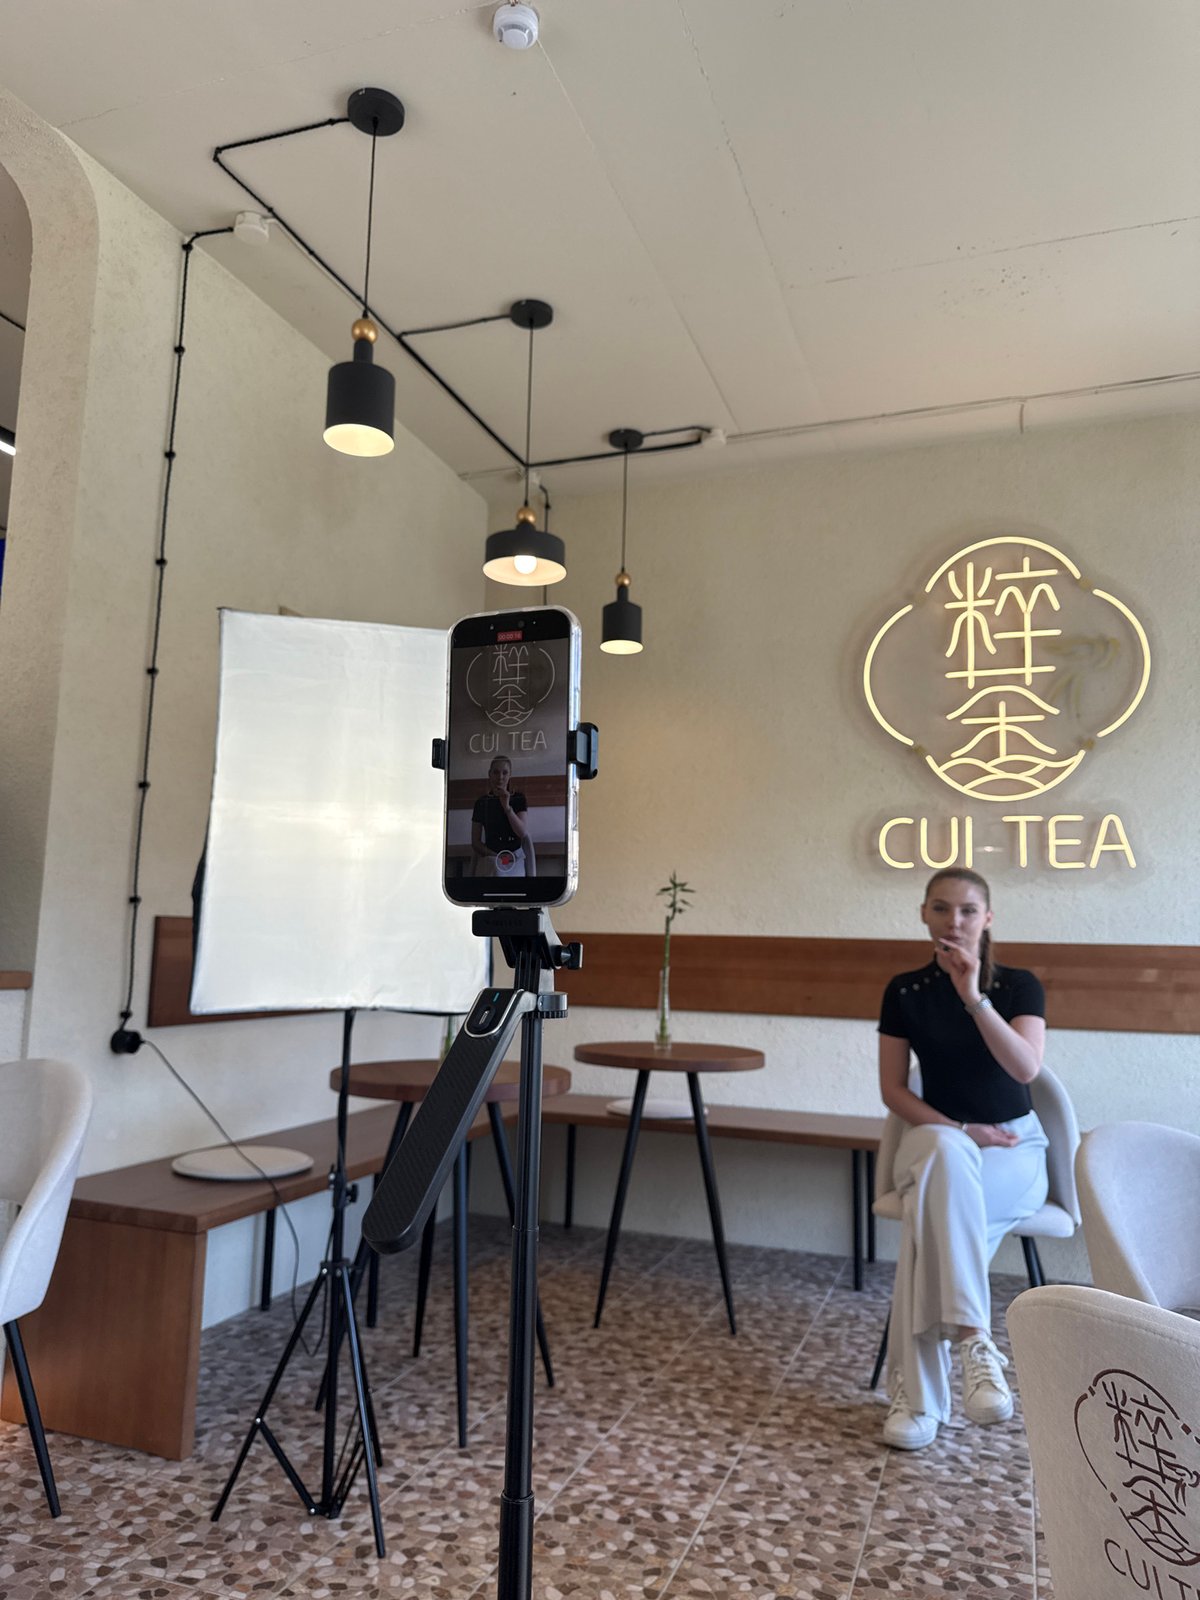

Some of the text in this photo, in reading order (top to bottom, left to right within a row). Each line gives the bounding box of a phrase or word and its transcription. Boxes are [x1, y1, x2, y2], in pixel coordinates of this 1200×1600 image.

[469, 730, 547, 753] CUI TEA
[878, 813, 1137, 869] CUI TEA
[1104, 1538, 1163, 1600] CUI
